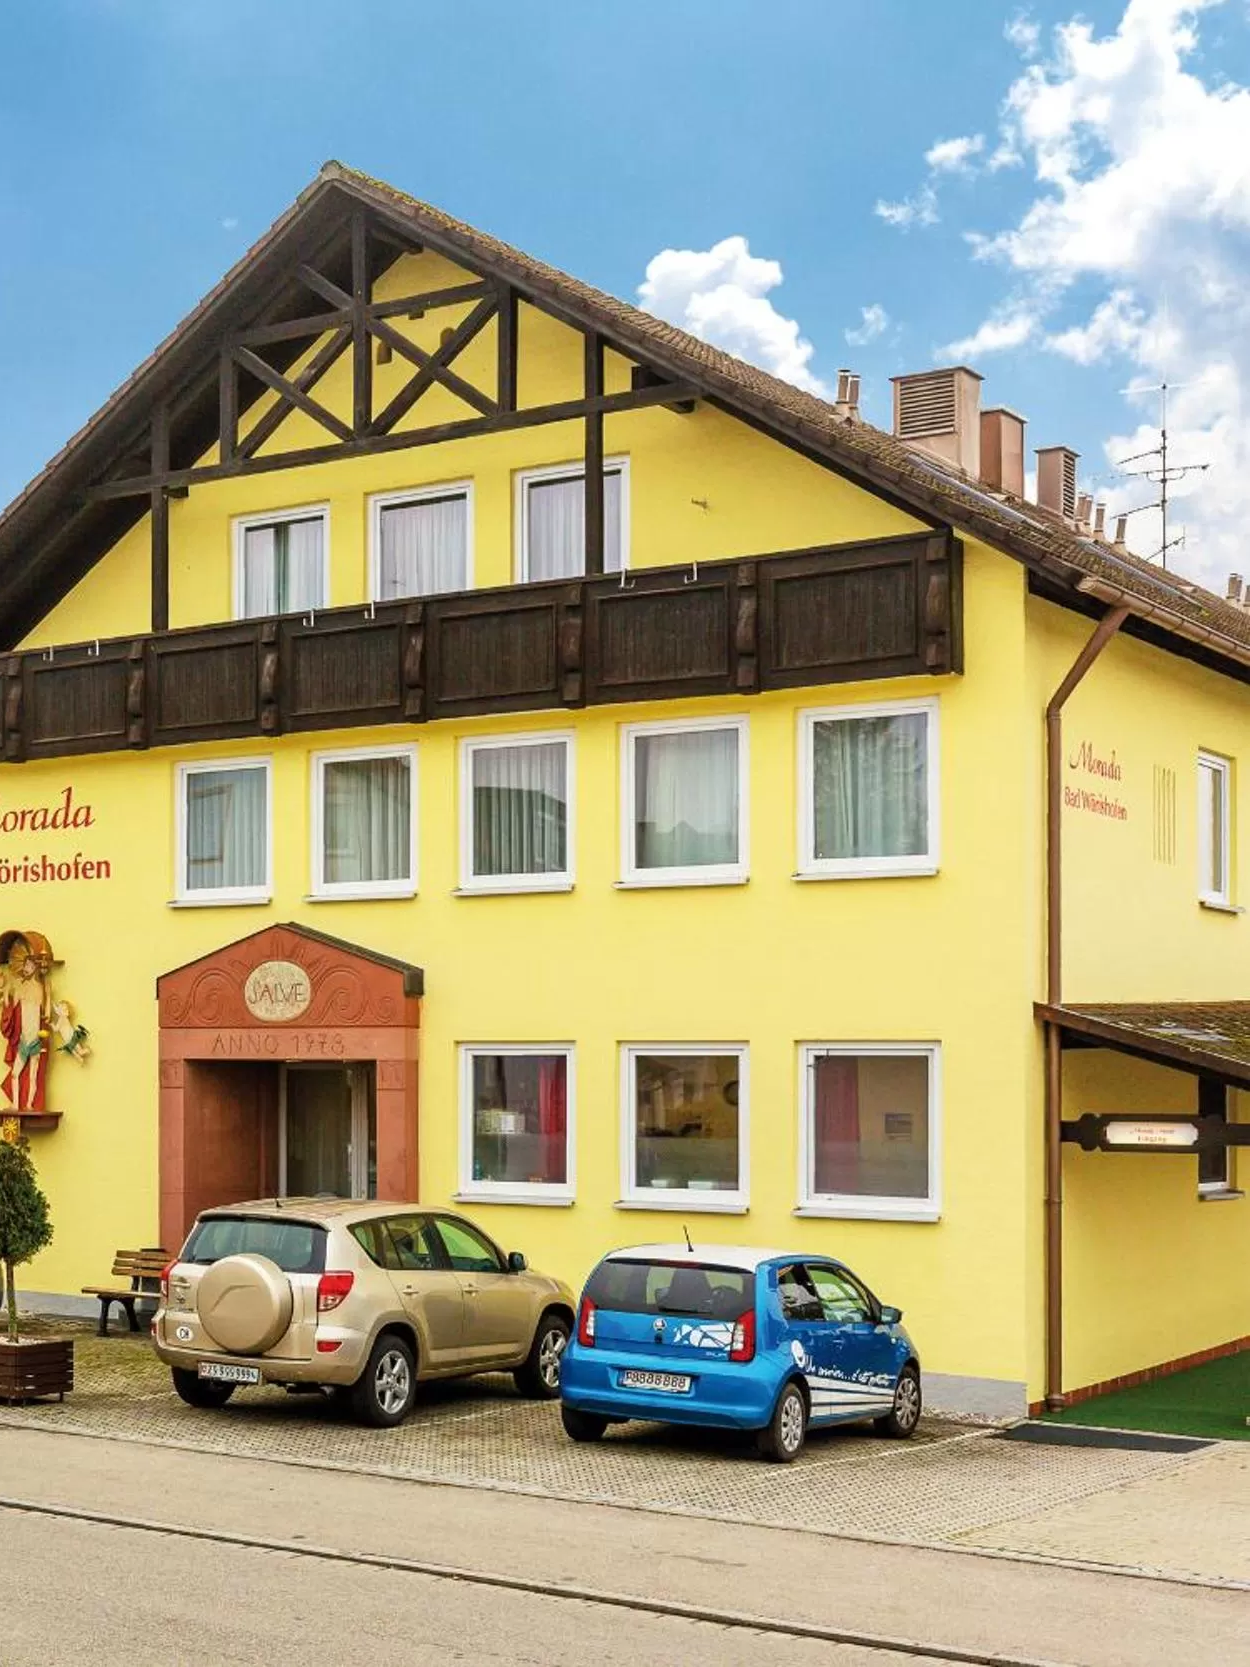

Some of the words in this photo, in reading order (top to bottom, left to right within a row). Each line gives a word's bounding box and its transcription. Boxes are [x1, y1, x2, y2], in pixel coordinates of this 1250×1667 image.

[1069, 741, 1121, 781] Morada
[1064, 786, 1081, 808] Bad
[249, 977, 306, 1005] SALVE
[211, 1033, 279, 1055] ANNO
